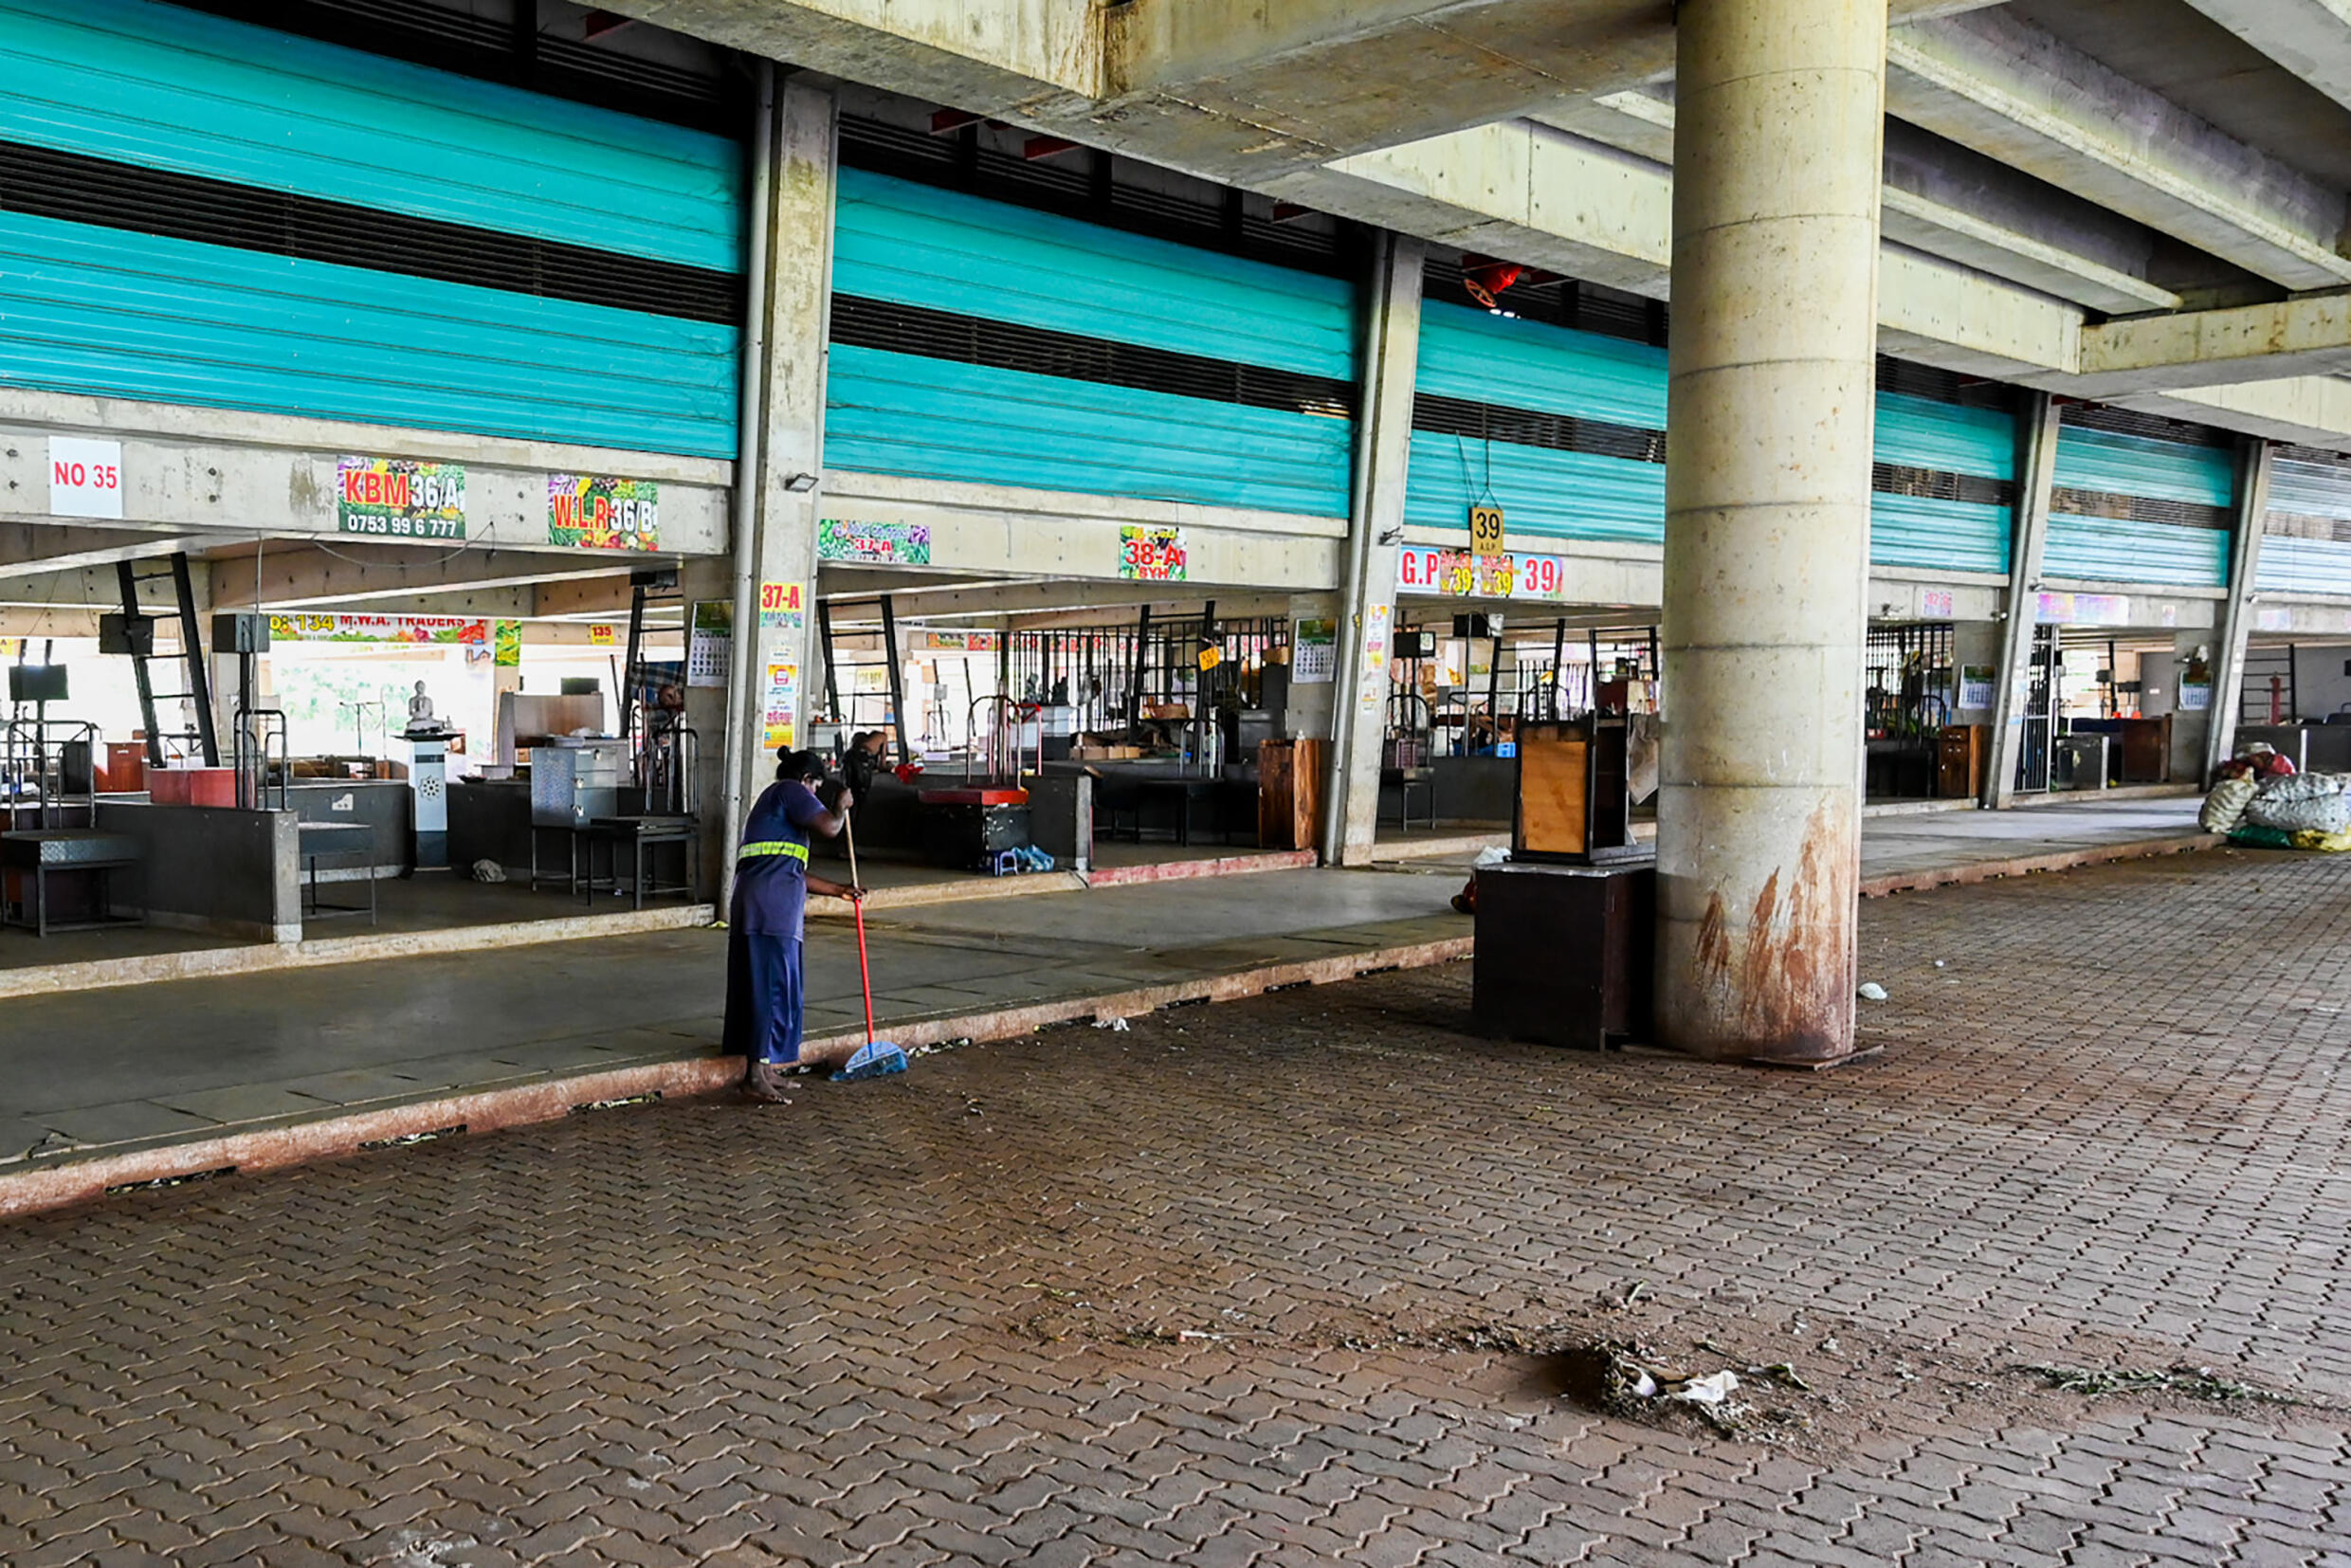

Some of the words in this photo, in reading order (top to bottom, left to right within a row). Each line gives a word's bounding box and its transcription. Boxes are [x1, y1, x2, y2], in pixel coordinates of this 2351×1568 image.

[54, 461, 85, 486] NO
[93, 465, 118, 489] 35
[344, 469, 409, 507] KBM
[410, 474, 459, 513] 36/A
[348, 515, 387, 533] 0753
[392, 518, 410, 534] 99
[415, 519, 425, 535] 6
[428, 520, 456, 537] 777
[554, 494, 607, 530] W.L.R
[610, 498, 653, 535] 36/B
[1476, 512, 1500, 539] 39
[1125, 541, 1182, 566] 38-A
[1452, 567, 1472, 593] 39
[1494, 570, 1512, 595] 39
[1524, 558, 1554, 592] 39
[762, 584, 800, 609] 37-A
[296, 613, 335, 631] 134
[592, 626, 611, 636] 135
